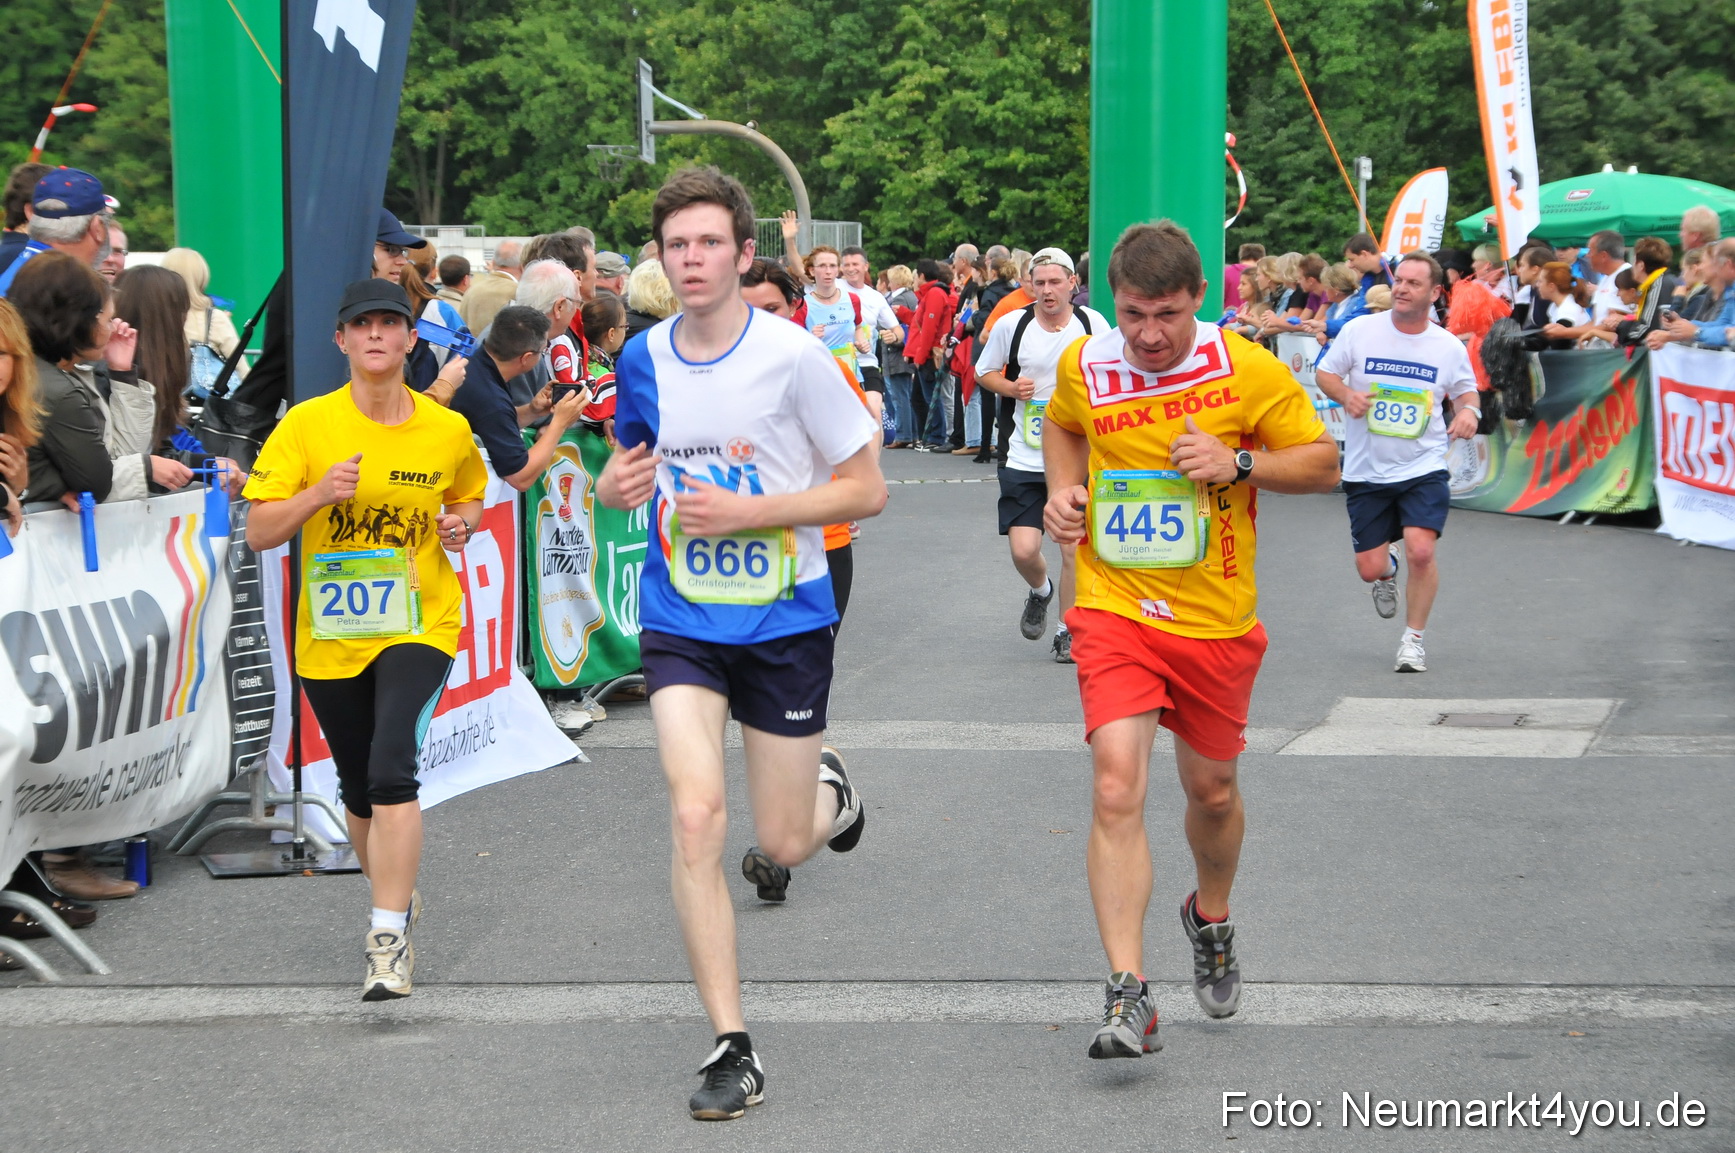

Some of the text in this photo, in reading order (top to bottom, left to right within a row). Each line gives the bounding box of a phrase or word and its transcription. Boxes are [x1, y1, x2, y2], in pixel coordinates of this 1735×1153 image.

[1375, 363, 1434, 379] STAEDTLER
[1093, 386, 1241, 437] MAX BÖGL
[1374, 401, 1418, 426] 893
[662, 445, 723, 459] expert
[389, 470, 428, 484] swn
[1105, 504, 1185, 542] 445
[685, 538, 769, 578] 666
[1119, 545, 1150, 556] Jürgen
[687, 577, 746, 589] Christopher
[319, 580, 396, 616] 207
[337, 617, 361, 626] Petra
[1, 589, 170, 765] swn
[785, 708, 813, 720] JAKO
